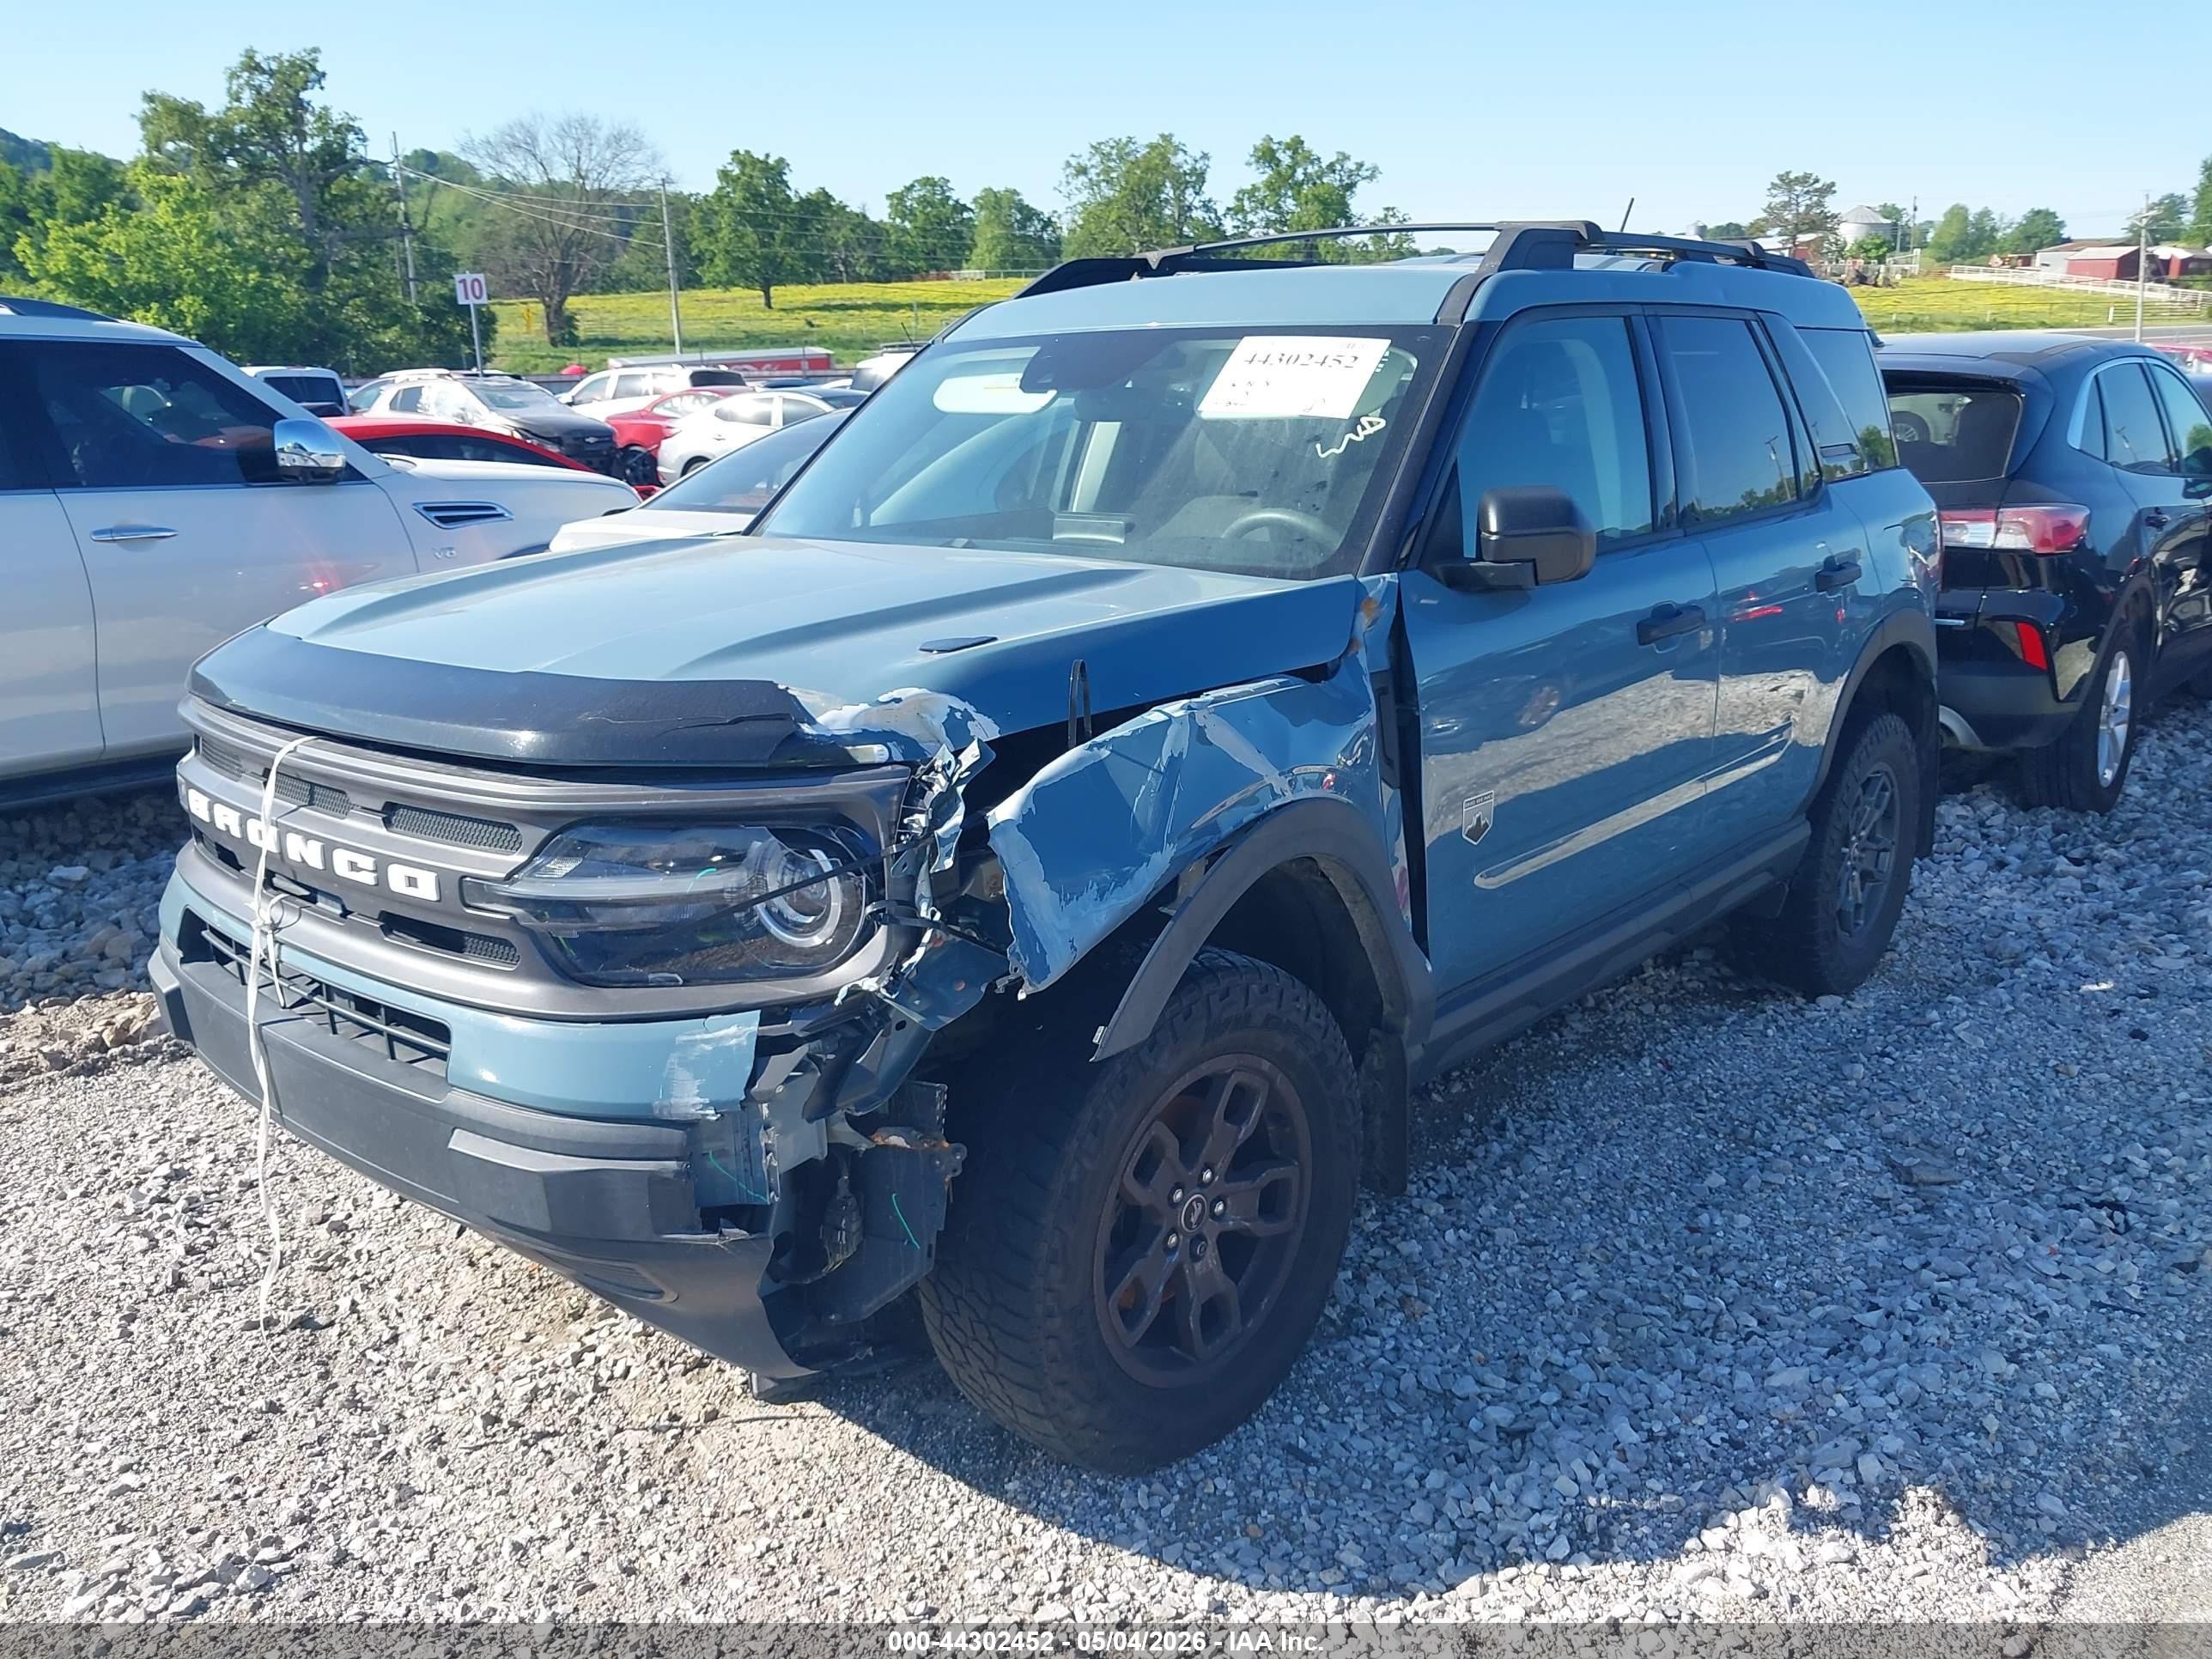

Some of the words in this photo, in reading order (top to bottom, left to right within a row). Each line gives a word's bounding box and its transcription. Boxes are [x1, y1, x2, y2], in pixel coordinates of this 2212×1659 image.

[459, 277, 483, 301] 10
[1244, 352, 1358, 369] 44302452
[186, 787, 441, 902] BRONCO
